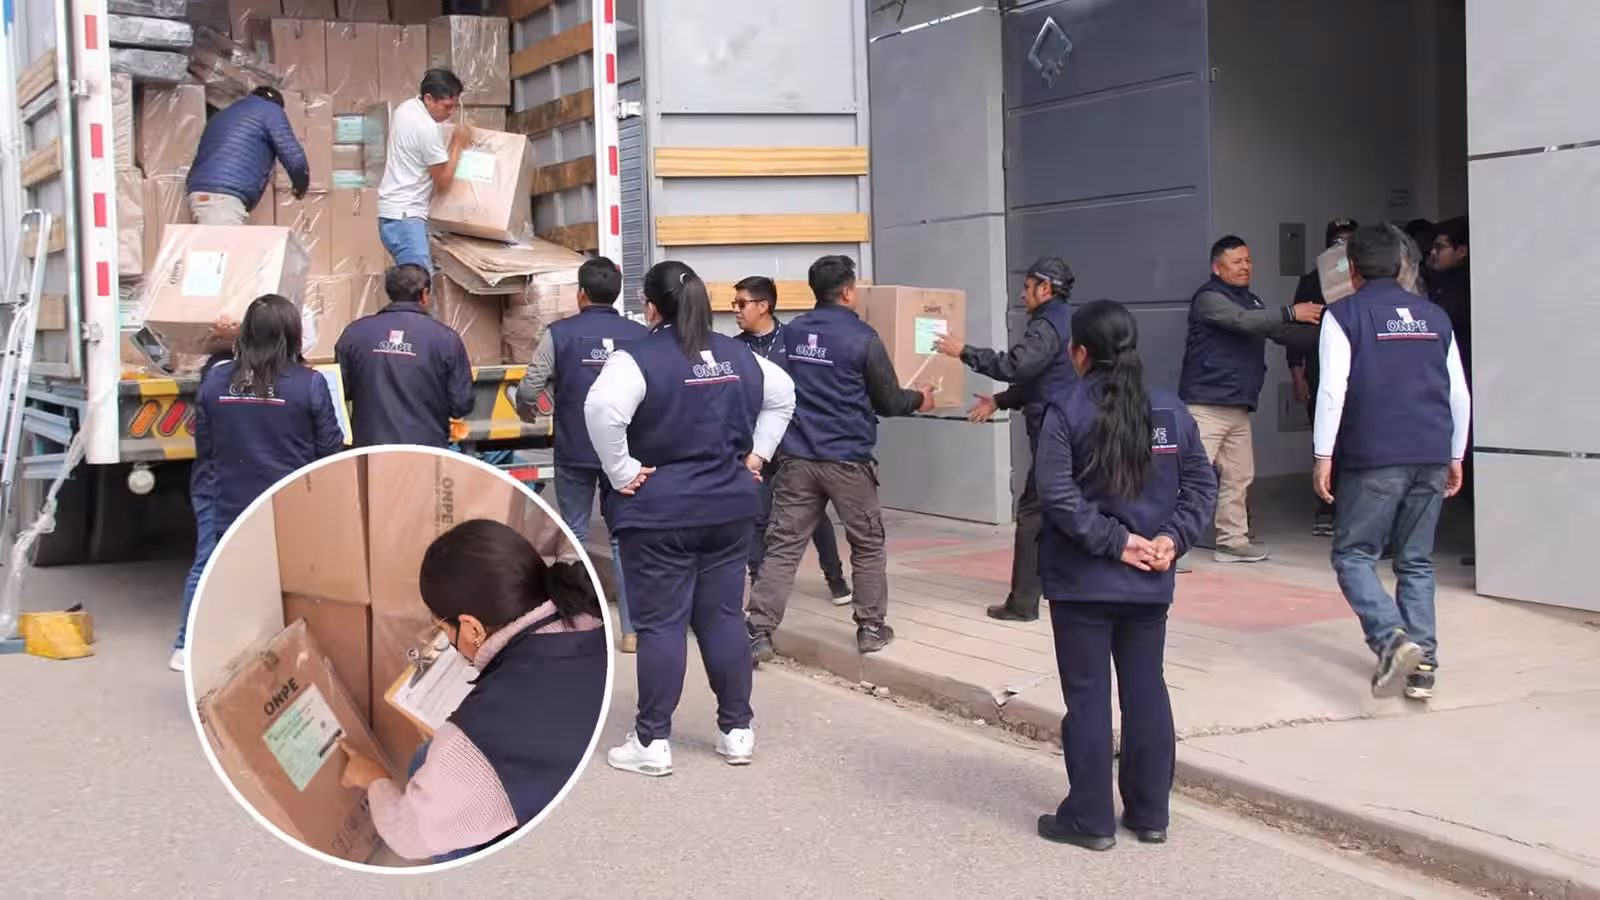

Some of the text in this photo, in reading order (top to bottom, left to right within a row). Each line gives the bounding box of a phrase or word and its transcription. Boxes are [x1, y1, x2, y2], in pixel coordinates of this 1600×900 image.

[1387, 319, 1428, 332] ONPE
[378, 340, 412, 353] ONPE
[795, 344, 827, 358] ONPE
[590, 348, 611, 360] ON
[692, 360, 734, 378] ONPE
[441, 477, 454, 524] ONPE
[263, 677, 299, 716] ONPE
